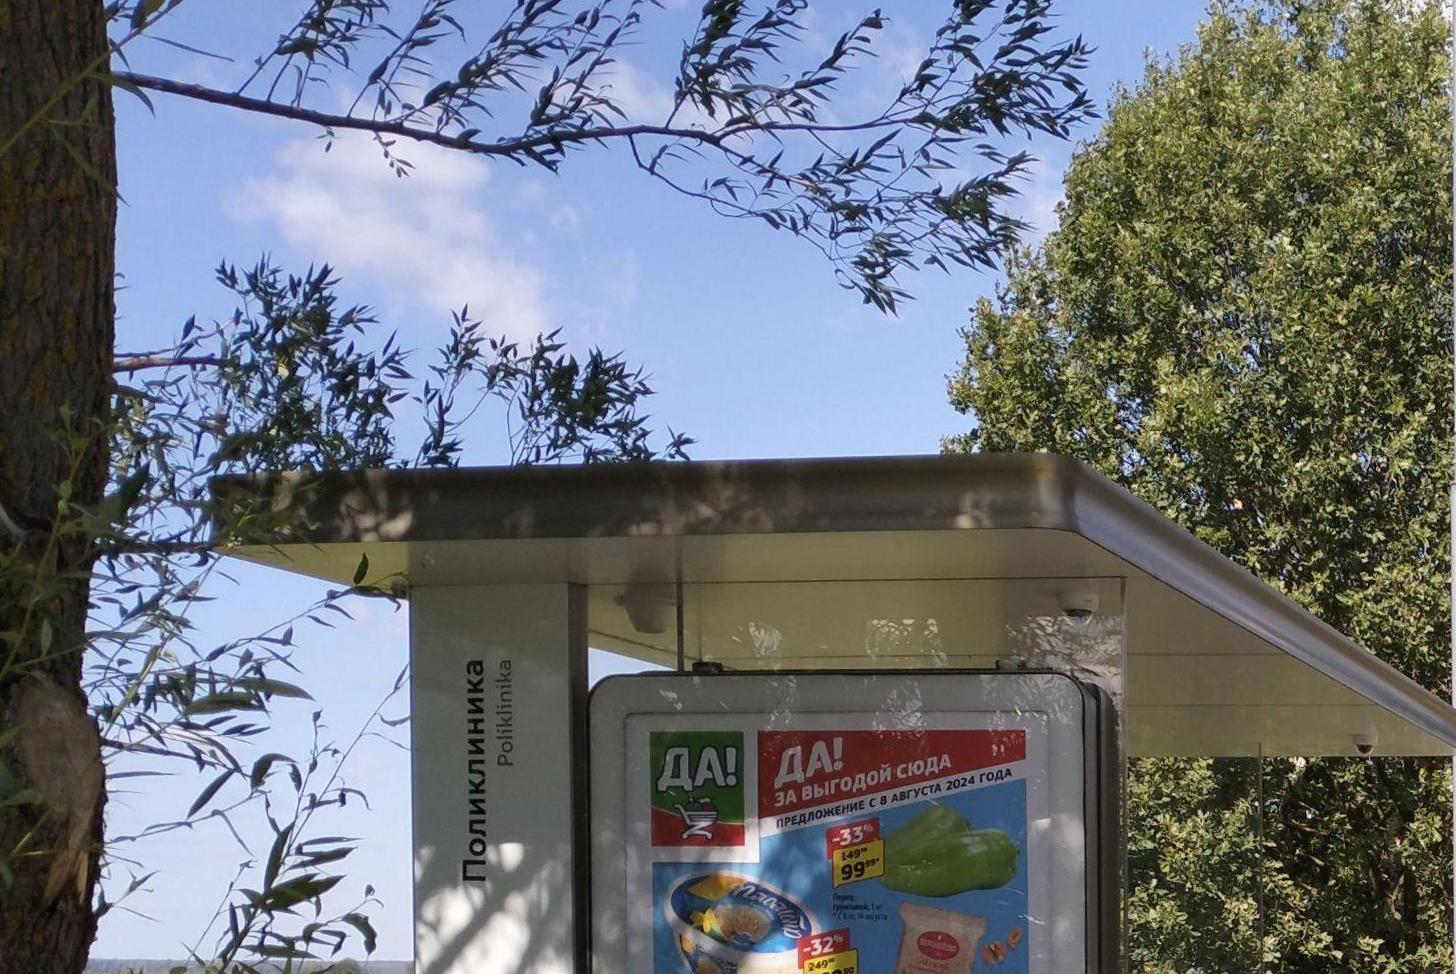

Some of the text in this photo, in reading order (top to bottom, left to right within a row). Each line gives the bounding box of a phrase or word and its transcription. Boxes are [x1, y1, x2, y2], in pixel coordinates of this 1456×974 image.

[495, 659, 514, 767] Poliklinika
[462, 659, 487, 882] Поликлиника
[657, 746, 737, 791] ДА!
[774, 737, 844, 789] ДА!
[774, 753, 952, 806] ЗА ВЫГОДОЙ СЮДА
[775, 767, 1013, 829] ПРЕДЛОЖЕНИЕ С 8 АВГУСТА 2024 ГОДА
[832, 823, 874, 846] -33%
[803, 935, 843, 956] -32%
